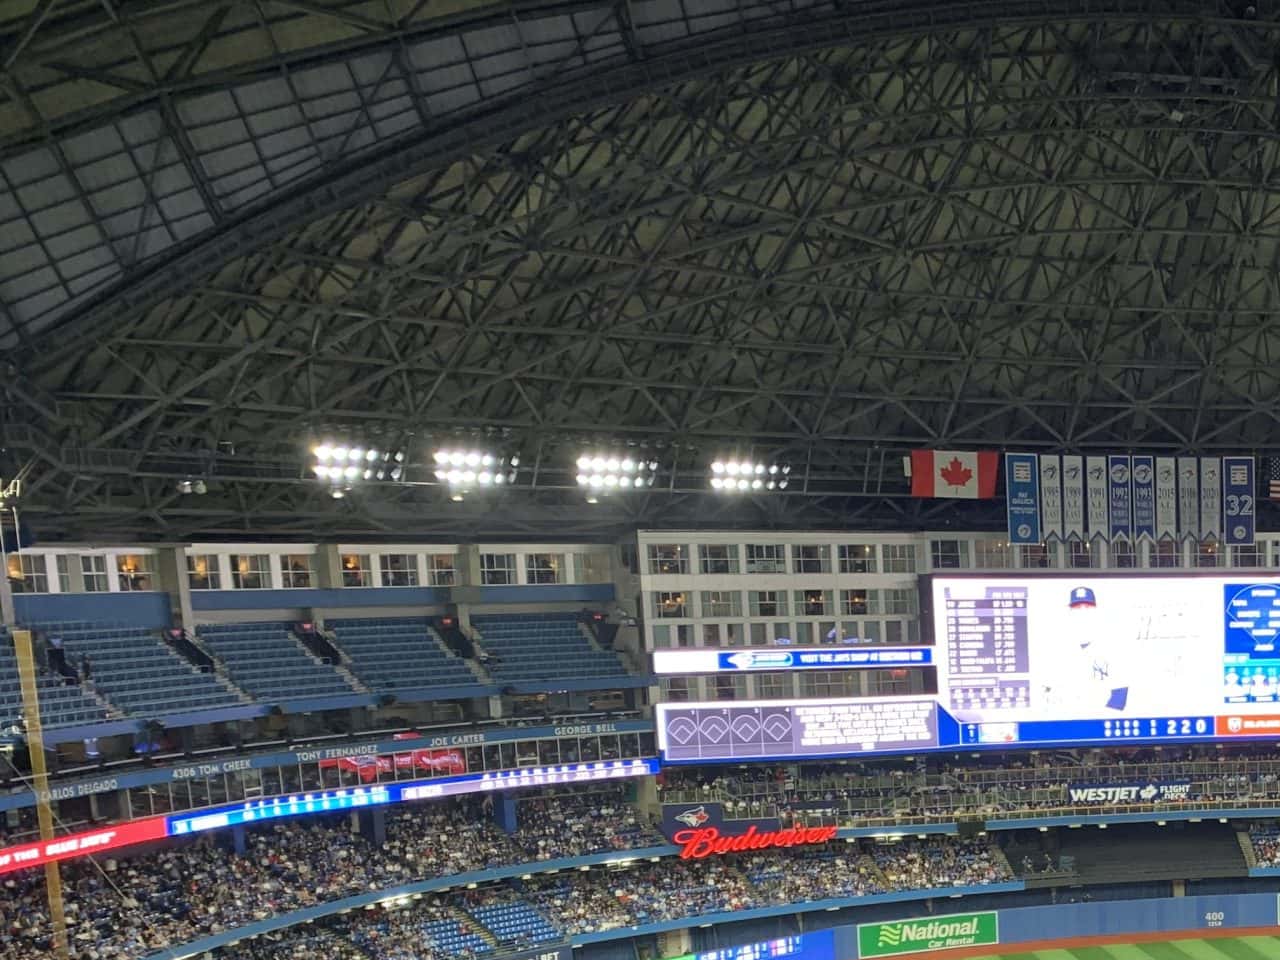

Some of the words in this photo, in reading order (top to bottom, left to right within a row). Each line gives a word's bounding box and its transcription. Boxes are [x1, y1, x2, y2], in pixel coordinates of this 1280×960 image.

[1226, 494, 1253, 516] 32
[554, 724, 594, 736] GEORGE
[596, 722, 617, 733] BELL
[1167, 720, 1176, 734] 2
[1182, 720, 1190, 734] 2
[1196, 720, 1206, 733] 0
[430, 736, 449, 747] JOE
[451, 733, 486, 744] CARTER
[296, 749, 324, 762] TONY
[326, 744, 379, 758] FERNANDEZ
[172, 764, 196, 778] 4306
[198, 762, 220, 776] TOM
[222, 758, 252, 772] CHEEK
[41, 787, 74, 801] CARLOS
[78, 778, 118, 796] DELGADO
[1070, 786, 1140, 804] WESTJET
[1160, 785, 1190, 794] FLIGHT
[673, 824, 838, 860] Budweiser
[13, 848, 40, 862] THE
[1204, 912, 1224, 920] 400
[928, 940, 944, 948] Car
[946, 936, 975, 947] Rental
